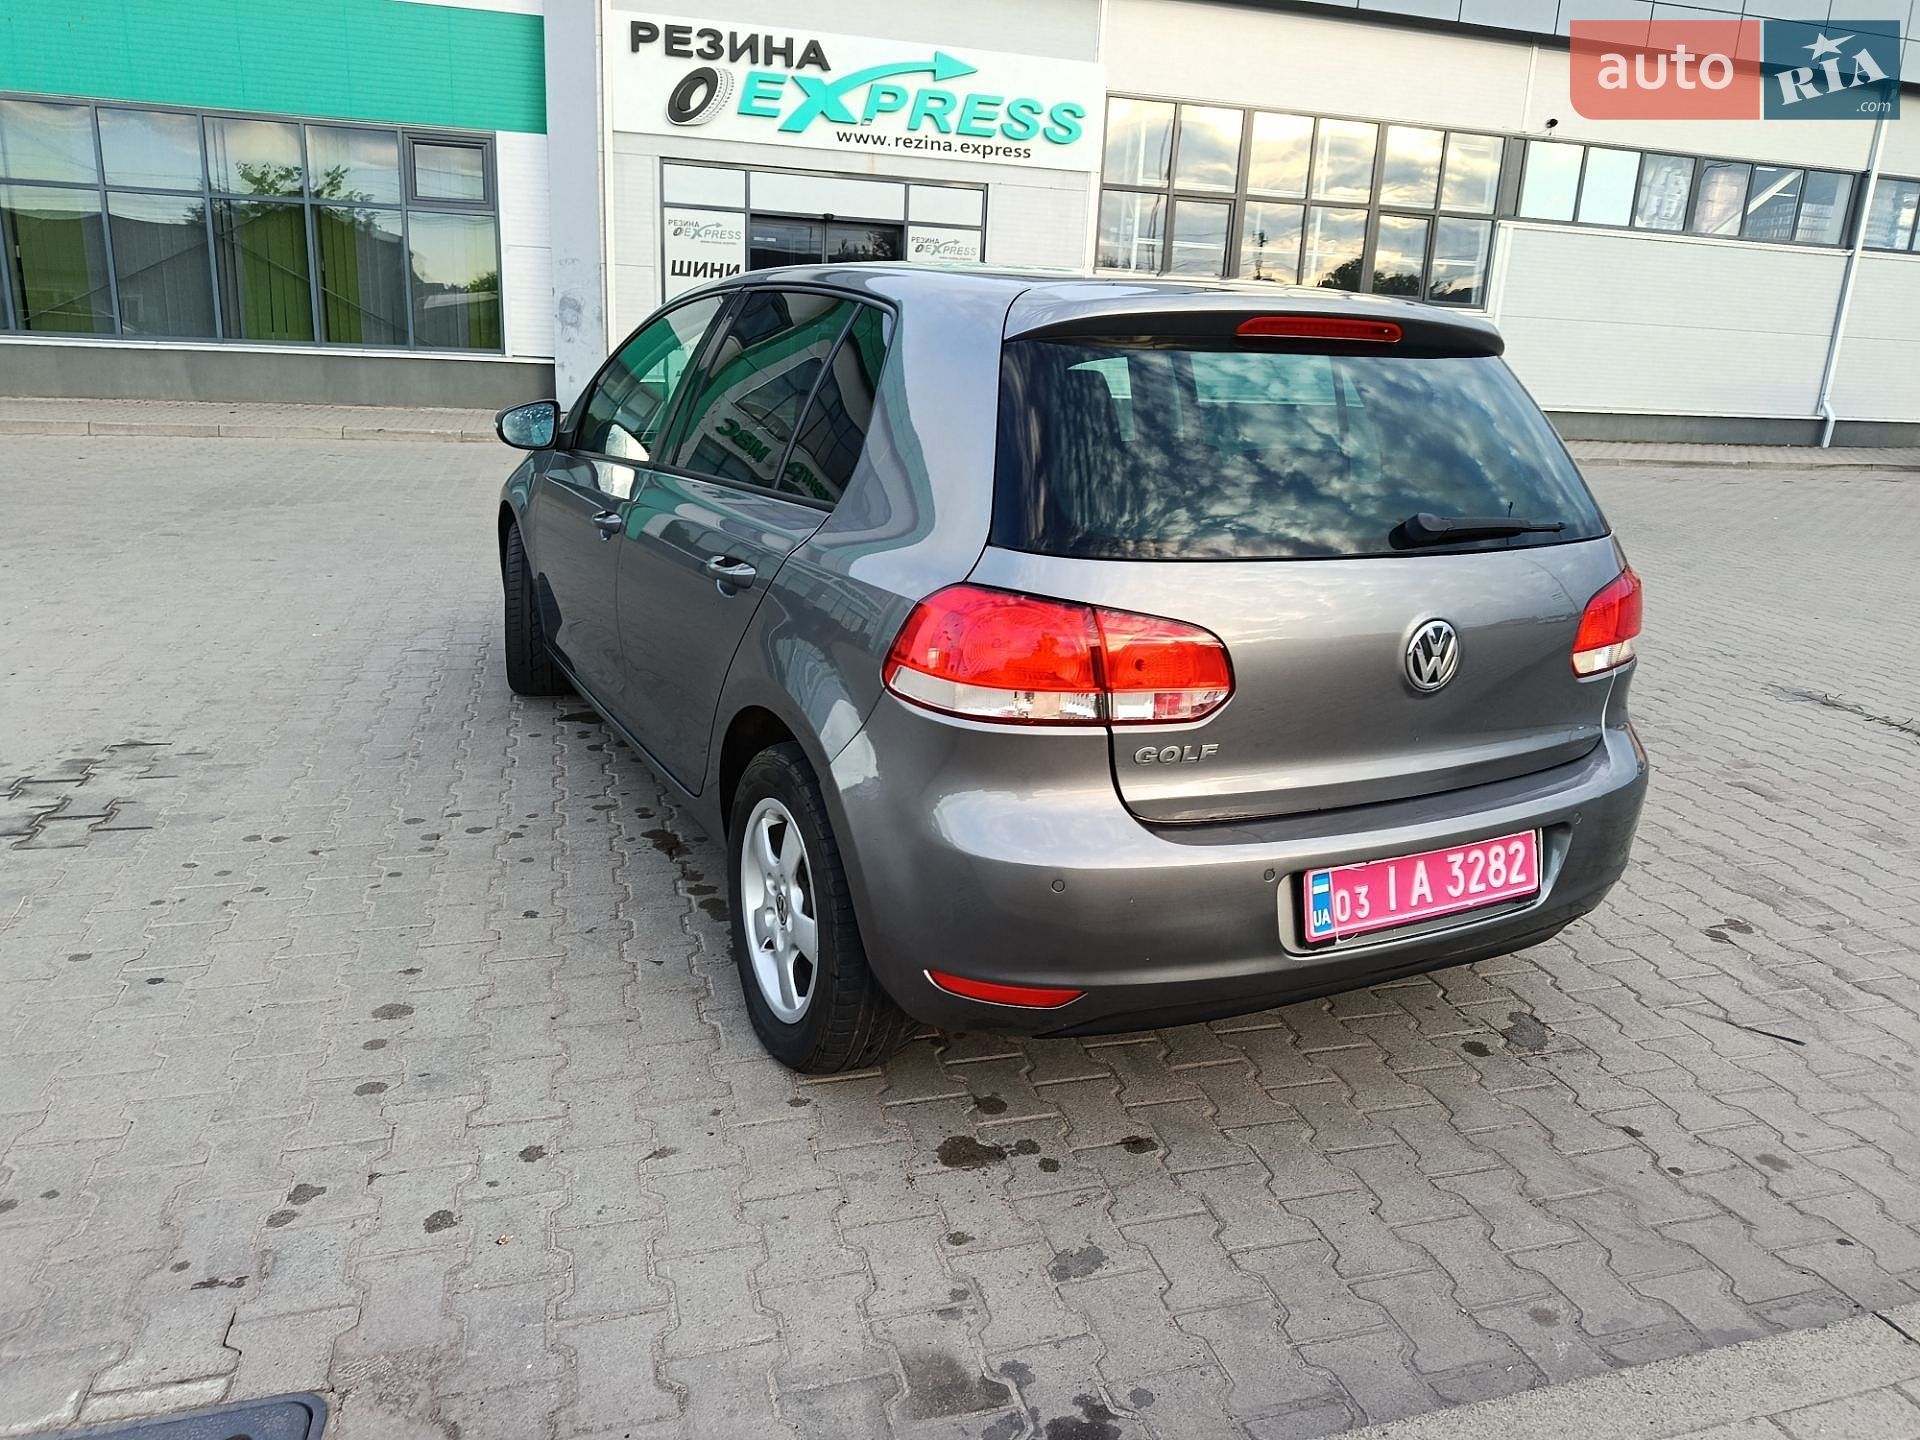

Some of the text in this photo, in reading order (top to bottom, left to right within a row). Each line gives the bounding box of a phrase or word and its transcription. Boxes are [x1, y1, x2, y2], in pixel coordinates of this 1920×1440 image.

[630, 20, 831, 71] РЕЗИНА
[737, 71, 1086, 145] EXPRESS
[836, 129, 1031, 159] www.rezina.express
[668, 219, 700, 228] РЕЗИНА
[671, 259, 741, 278] ШИНИ
[1133, 743, 1220, 765] GOLF
[1335, 884, 1370, 923] 03
[1446, 840, 1527, 898] 3282
[1313, 909, 1332, 927] UA
